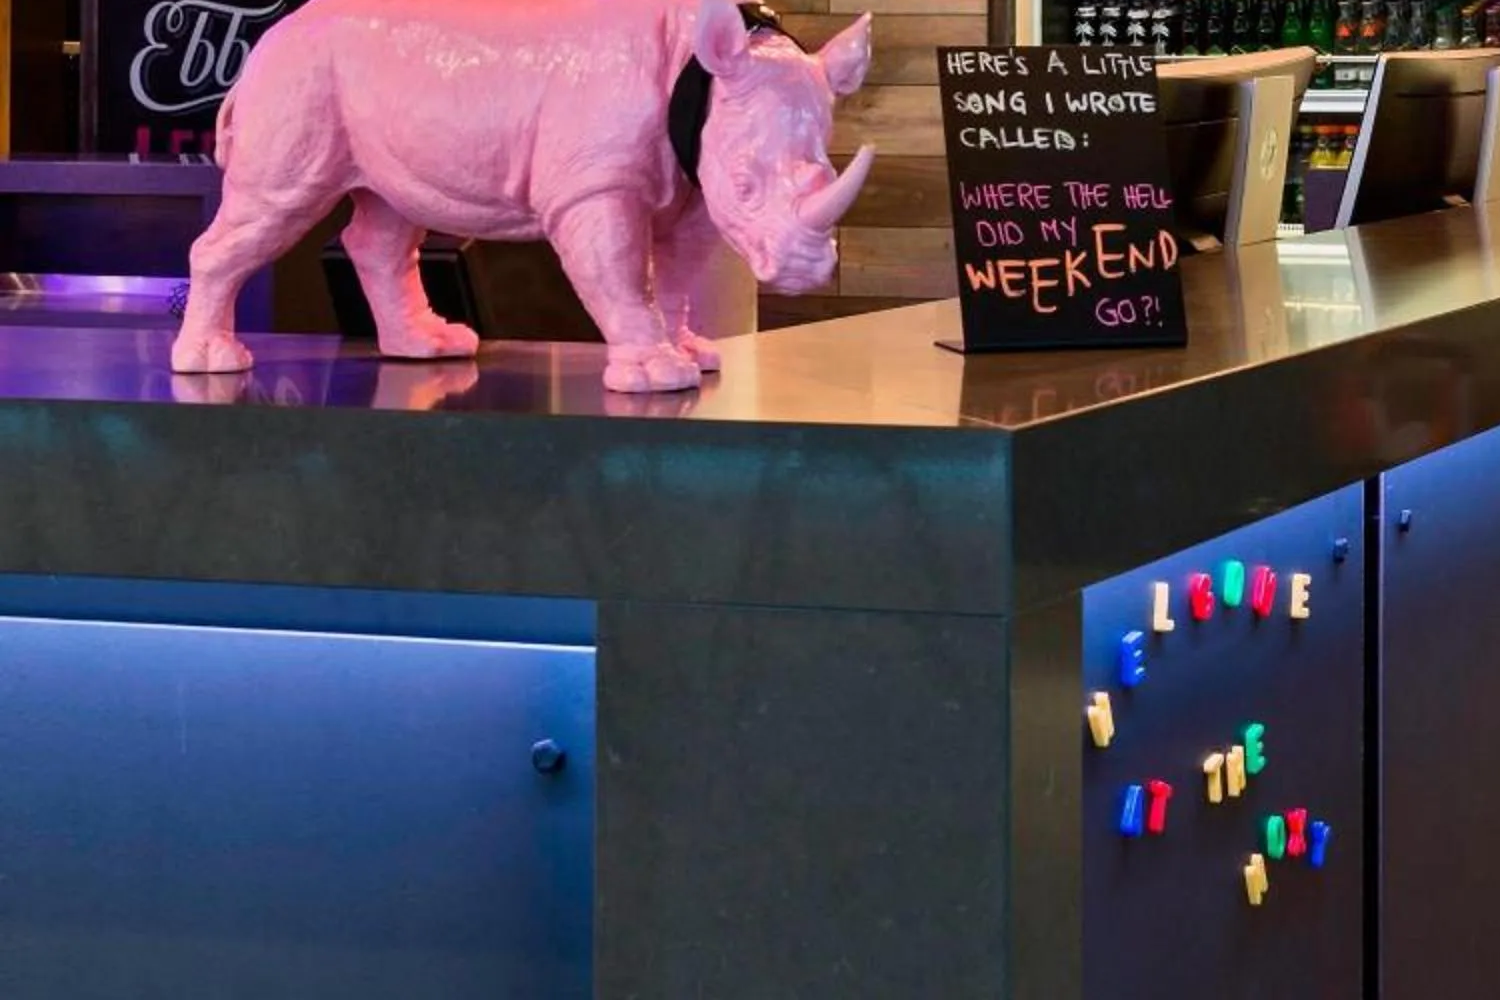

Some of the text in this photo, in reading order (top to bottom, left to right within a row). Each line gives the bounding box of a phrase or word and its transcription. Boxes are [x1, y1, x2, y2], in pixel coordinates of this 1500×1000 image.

[946, 48, 1154, 80] HERE'S A LITTLE
[954, 90, 1157, 117] SONG I WROTE
[958, 180, 1174, 211] WHERE THE HELL
[975, 216, 1081, 248] DID MY
[964, 222, 1179, 314] WEEKEND
[1095, 294, 1164, 328] GO?!
